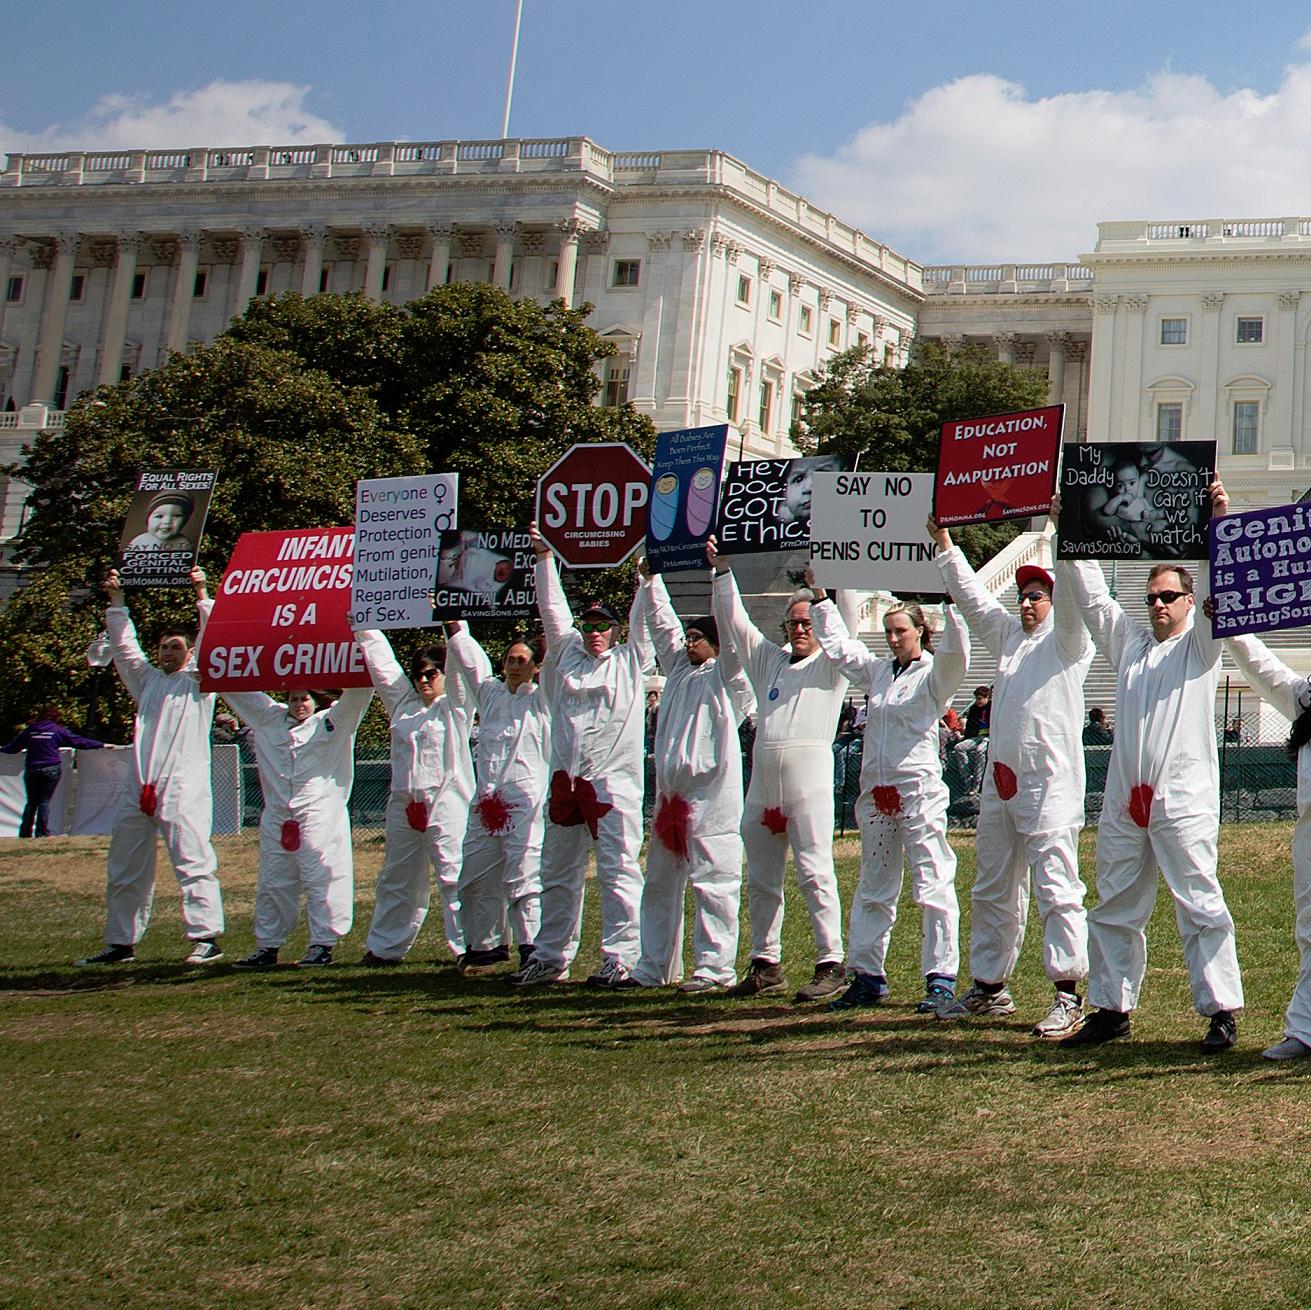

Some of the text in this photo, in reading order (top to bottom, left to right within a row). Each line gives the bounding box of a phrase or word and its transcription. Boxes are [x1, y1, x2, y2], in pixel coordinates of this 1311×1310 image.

[982, 443, 1018, 459] NOT
[1079, 445, 1101, 465] My
[943, 460, 1049, 486] AMPUTATION
[1065, 466, 1213, 488] Daddy Doesn't
[836, 475, 912, 496] SAY NO
[361, 488, 427, 504] Everyone
[1153, 487, 1208, 508] Care if
[545, 482, 648, 528] STOP
[360, 508, 426, 523] Deserves
[860, 509, 886, 528] TO
[1165, 509, 1188, 524] we
[359, 527, 432, 542] Protection
[564, 530, 626, 539] CIRCUMCISING
[358, 545, 438, 563] From genit
[810, 541, 860, 560] PENIS
[1060, 540, 1141, 554] SavingSons.org
[123, 552, 193, 560] FORCED
[127, 559, 187, 567] GENITAL
[119, 566, 192, 574] CUTTING
[357, 567, 433, 582] Mutilation,
[1215, 570, 1235, 586] is
[1246, 569, 1260, 582] a
[223, 563, 353, 595] CIRCUMCIS
[356, 586, 435, 605] Regardless
[436, 590, 500, 607] GENITAL
[271, 603, 316, 627] IS A
[356, 607, 410, 623] of Sex.
[207, 641, 365, 679] SEX CRIME
